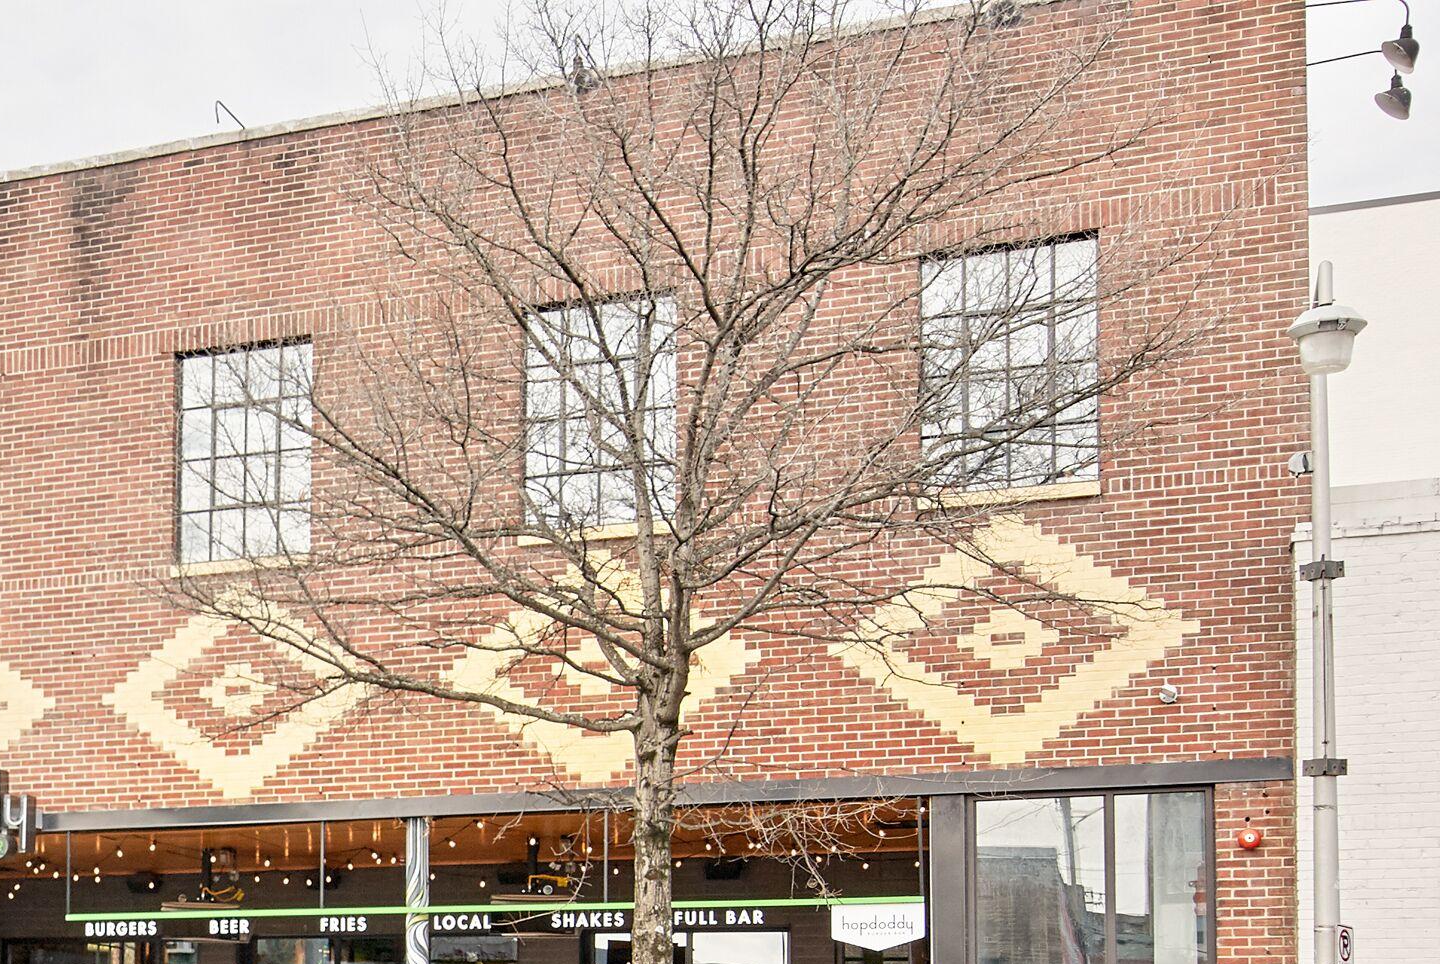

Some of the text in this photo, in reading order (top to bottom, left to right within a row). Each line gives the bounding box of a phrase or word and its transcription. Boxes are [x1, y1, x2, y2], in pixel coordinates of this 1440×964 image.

[319, 916, 367, 933] FRIES
[433, 914, 491, 930] LOCAL
[550, 912, 625, 929] SHAKES
[673, 909, 765, 926] FULL BAR
[842, 914, 914, 936] hopdoddy
[84, 920, 157, 937] BURGERS
[209, 918, 250, 935] BEER
